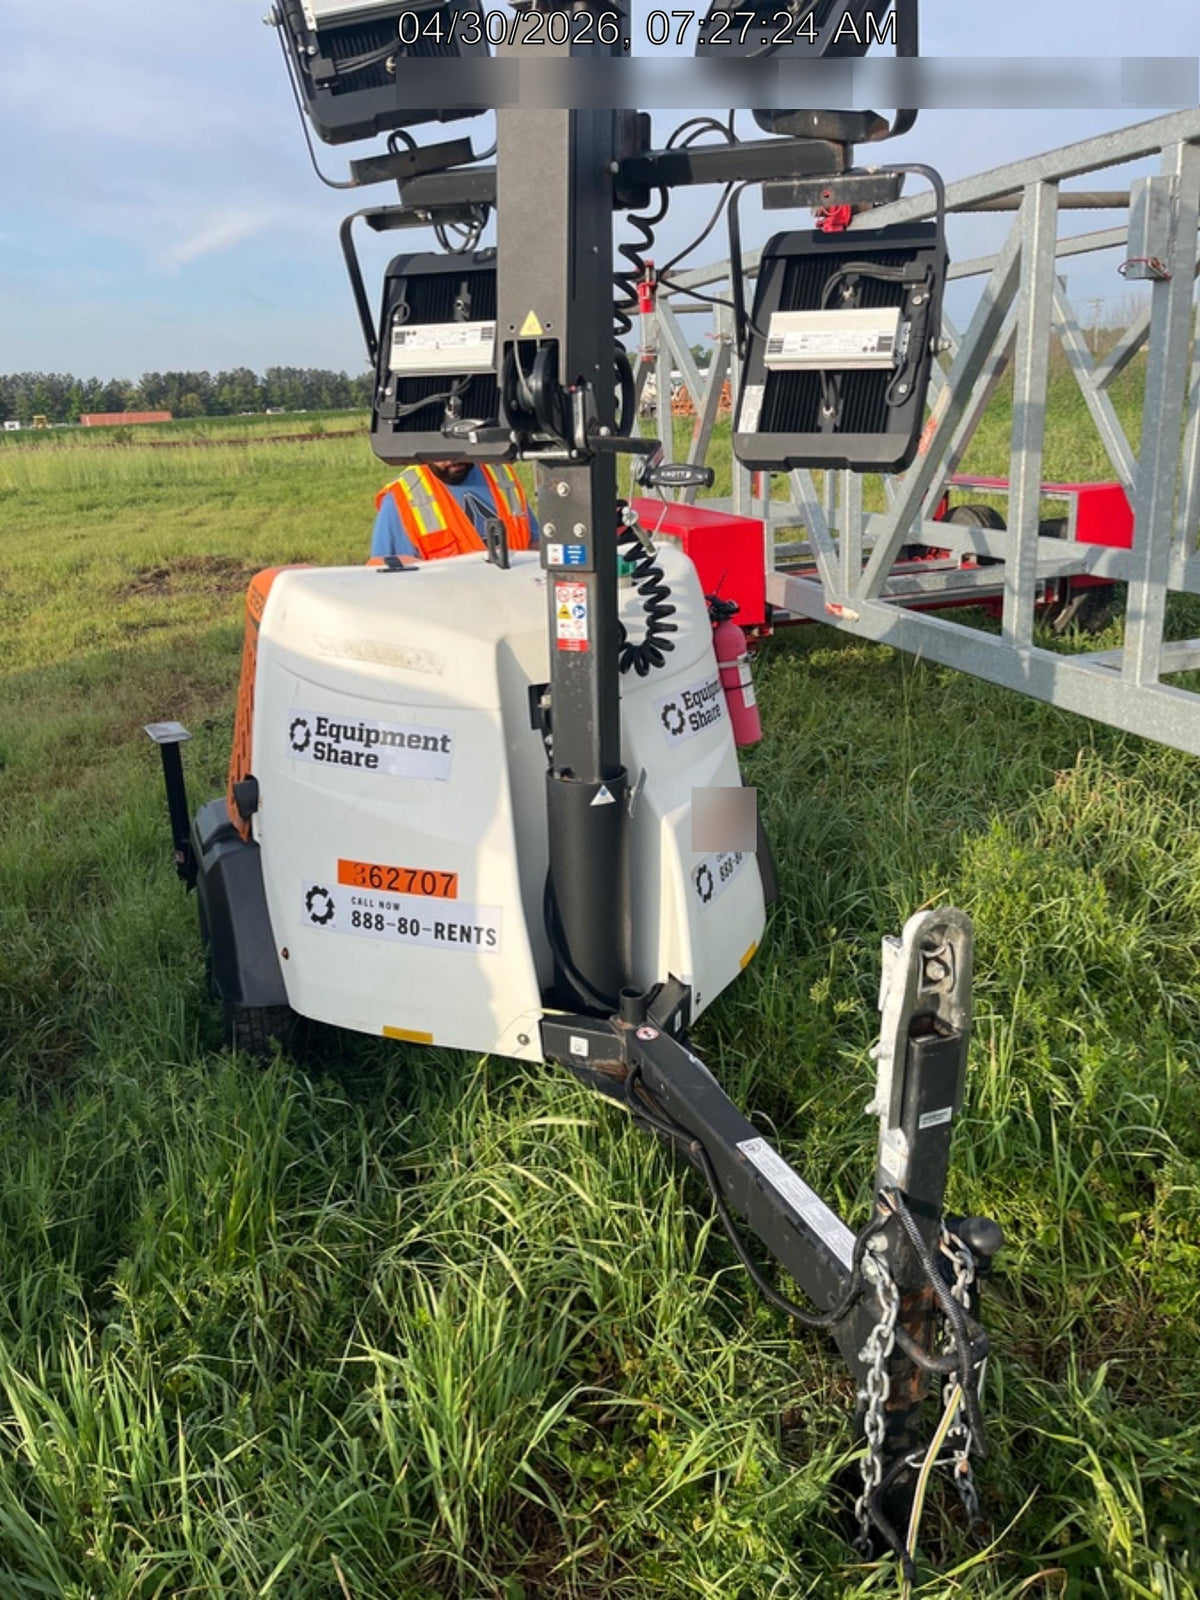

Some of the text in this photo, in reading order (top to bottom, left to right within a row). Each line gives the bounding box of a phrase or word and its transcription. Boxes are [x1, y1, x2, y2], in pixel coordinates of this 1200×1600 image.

[314, 716, 452, 753] Equipment
[313, 741, 379, 769] Share
[352, 862, 456, 897] 362707
[351, 896, 401, 911] CALL NOW
[351, 909, 497, 946] 888-80-RENTS
